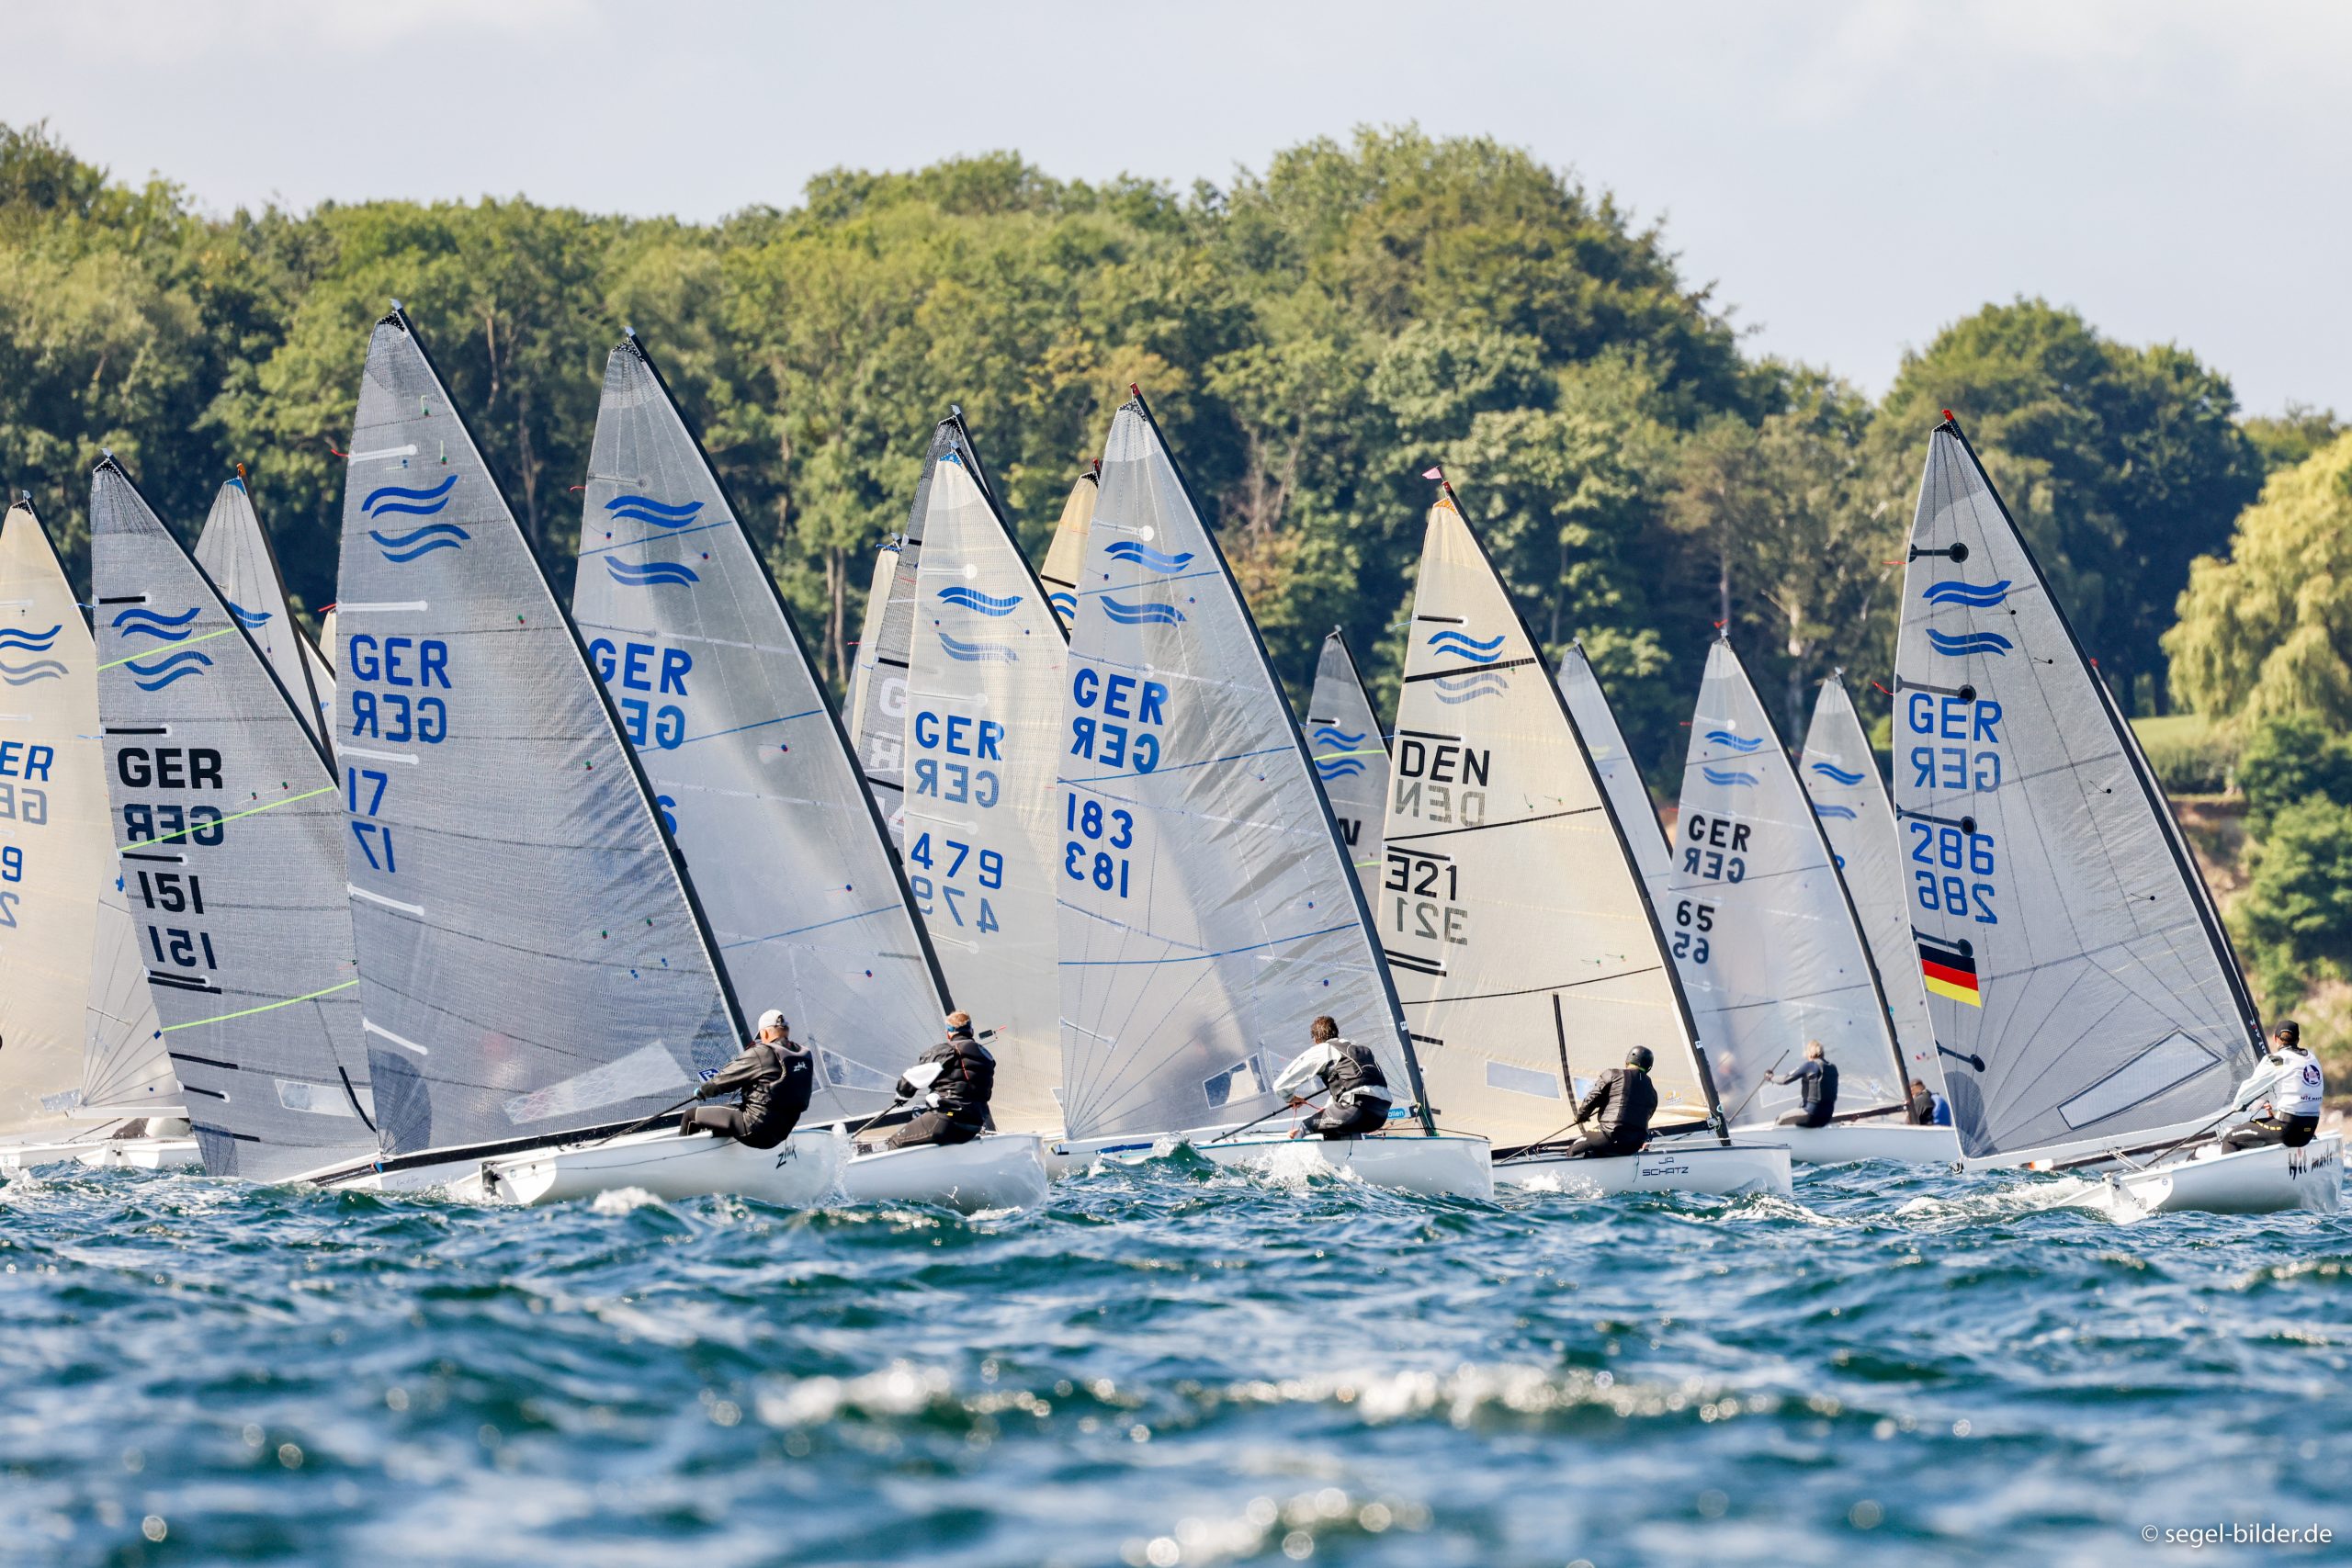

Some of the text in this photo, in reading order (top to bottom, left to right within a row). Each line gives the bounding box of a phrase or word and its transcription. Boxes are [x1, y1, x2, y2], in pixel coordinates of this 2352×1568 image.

[349, 634, 452, 689] GER
[588, 637, 693, 696] GER
[1073, 668, 1169, 726] GER
[1908, 693, 2003, 744] GER
[914, 711, 1005, 761] GER
[0, 741, 53, 782] ER
[117, 748, 223, 789] GER
[1399, 740, 1489, 787] DEN
[348, 767, 388, 817] 17
[1068, 792, 1134, 850] 183
[1688, 814, 1752, 853] GER
[910, 832, 1003, 889] 479
[1909, 822, 1995, 875] 286
[137, 870, 204, 915] 151
[1385, 853, 1458, 901] 321
[1676, 899, 1714, 932] 65
[1642, 1166, 1690, 1177] SCHATZ
